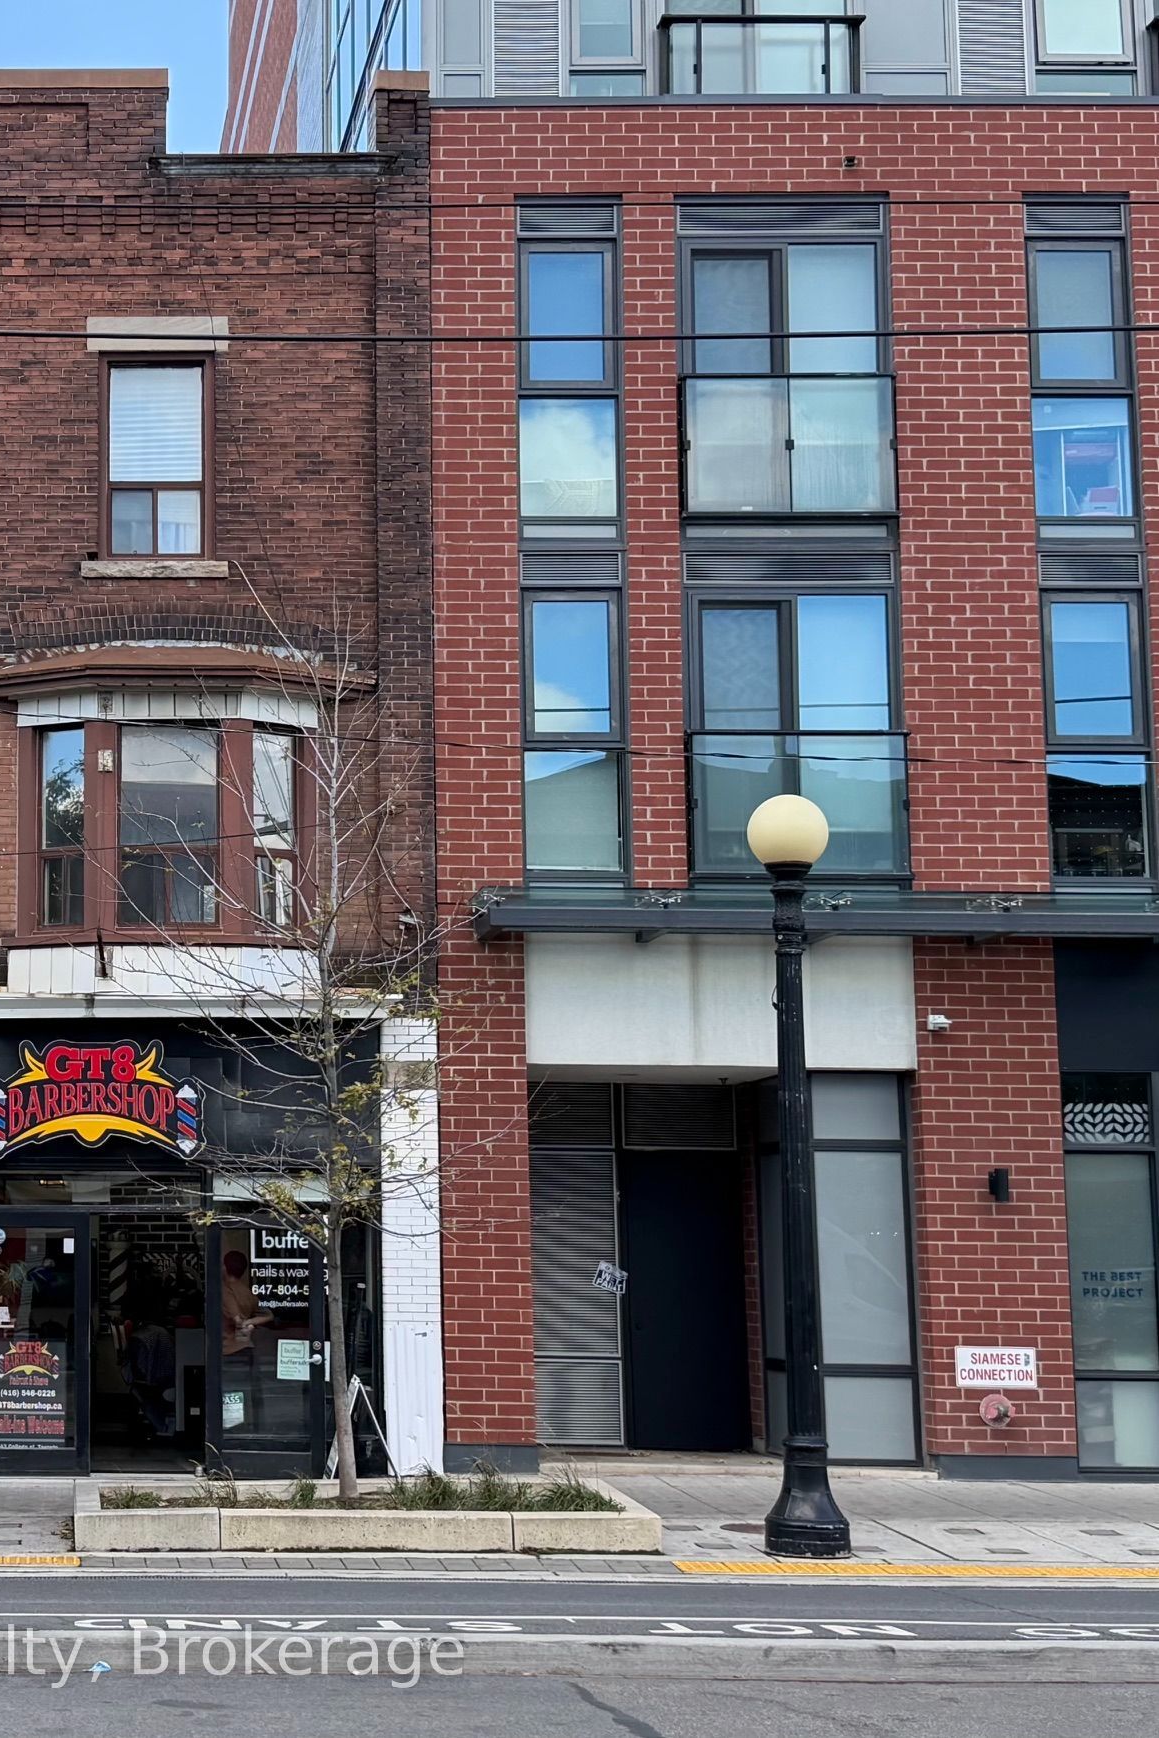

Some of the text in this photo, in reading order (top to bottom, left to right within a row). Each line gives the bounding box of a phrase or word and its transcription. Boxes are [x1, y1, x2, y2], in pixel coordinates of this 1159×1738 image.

[44, 1045, 137, 1083] GT8
[7, 1081, 176, 1138] BARBERSHOP
[261, 1229, 309, 1249] buffe
[250, 1264, 278, 1278] nails
[278, 1268, 286, 1278] &
[1082, 1271, 1143, 1282] THE BEST
[1082, 1287, 1144, 1298] PROJECT
[15, 1341, 42, 1354] GT8
[4, 1353, 54, 1372] BARBERSHOP
[970, 1352, 1021, 1365] SIAMESE
[959, 1368, 1034, 1382] CONNECTION
[0, 1389, 20, 1398] (416)
[648, 1622, 919, 1636] NOT
